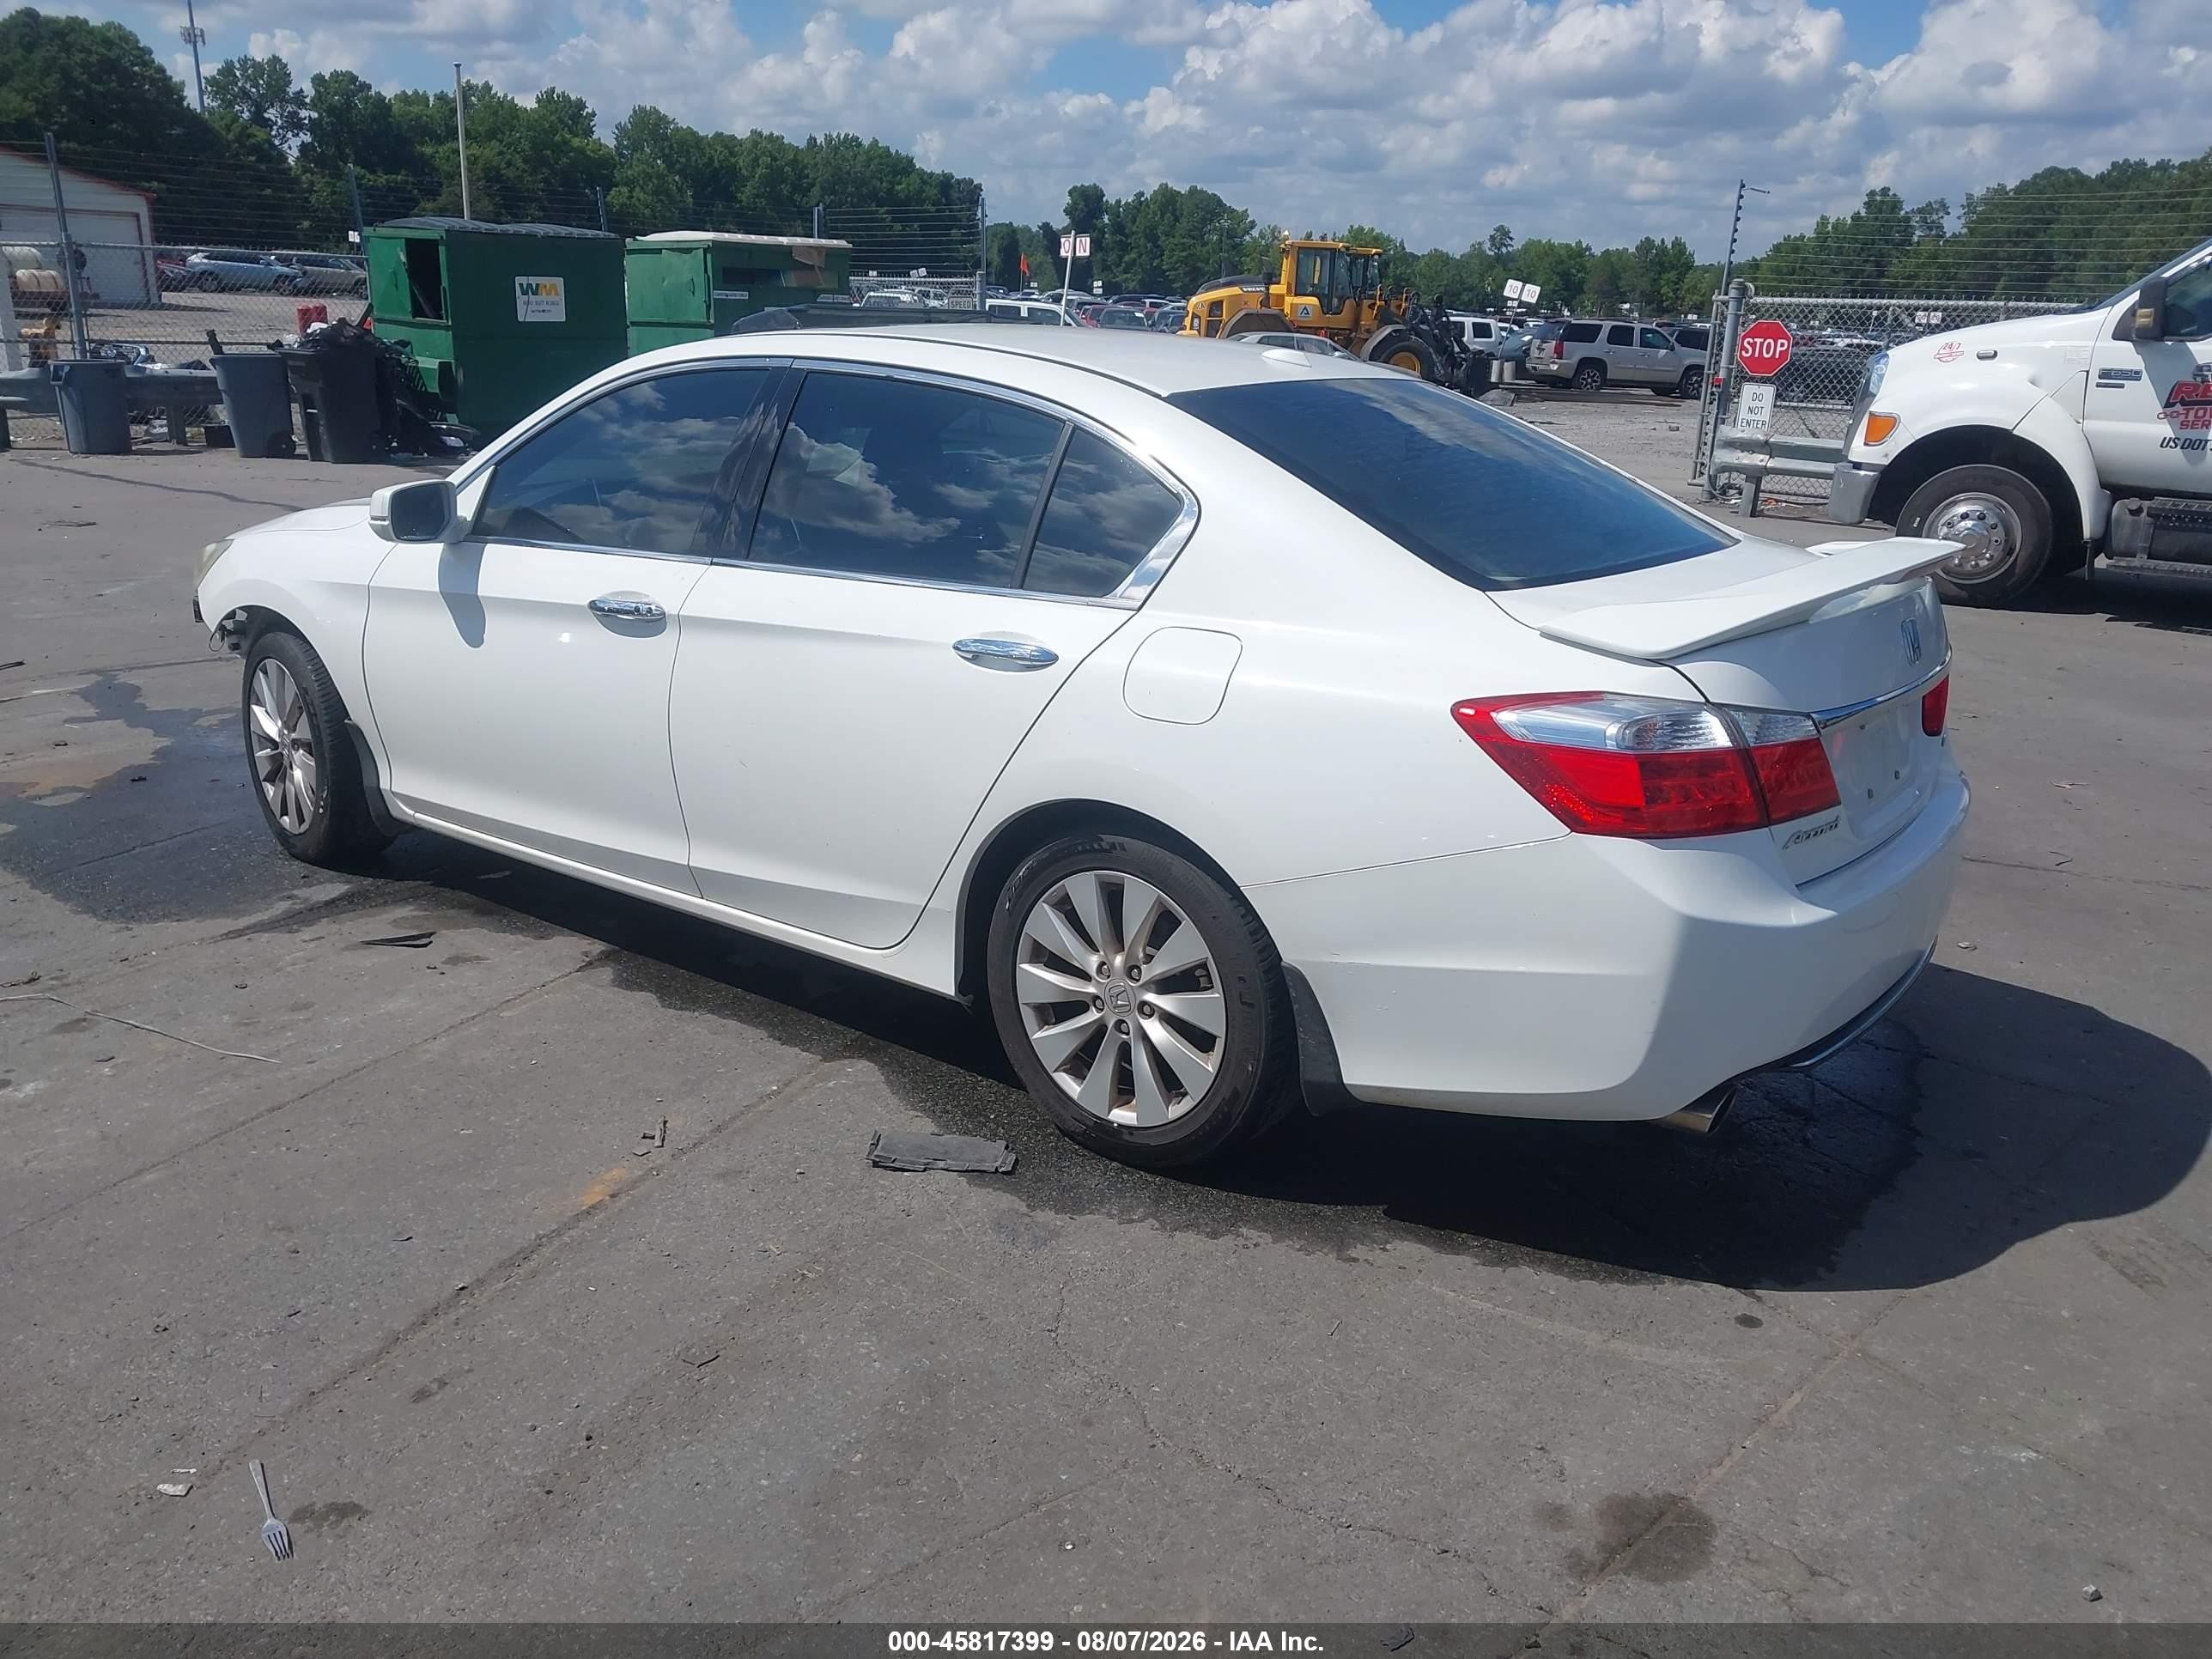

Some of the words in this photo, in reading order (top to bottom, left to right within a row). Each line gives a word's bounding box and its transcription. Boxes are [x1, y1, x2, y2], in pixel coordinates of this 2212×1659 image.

[519, 283, 559, 296] WM
[1509, 285, 1519, 294] 10
[1526, 289, 1537, 299] 10
[951, 301, 971, 309] SPEED
[1741, 337, 1789, 359] STOP
[1942, 342, 1961, 351] 24/7
[1752, 392, 1764, 403] DO
[1747, 404, 1765, 416] NOT
[2182, 407, 2212, 419] TO
[1740, 418, 1767, 430] ENTER
[2160, 436, 2180, 449] US
[2180, 437, 2209, 451] DOT
